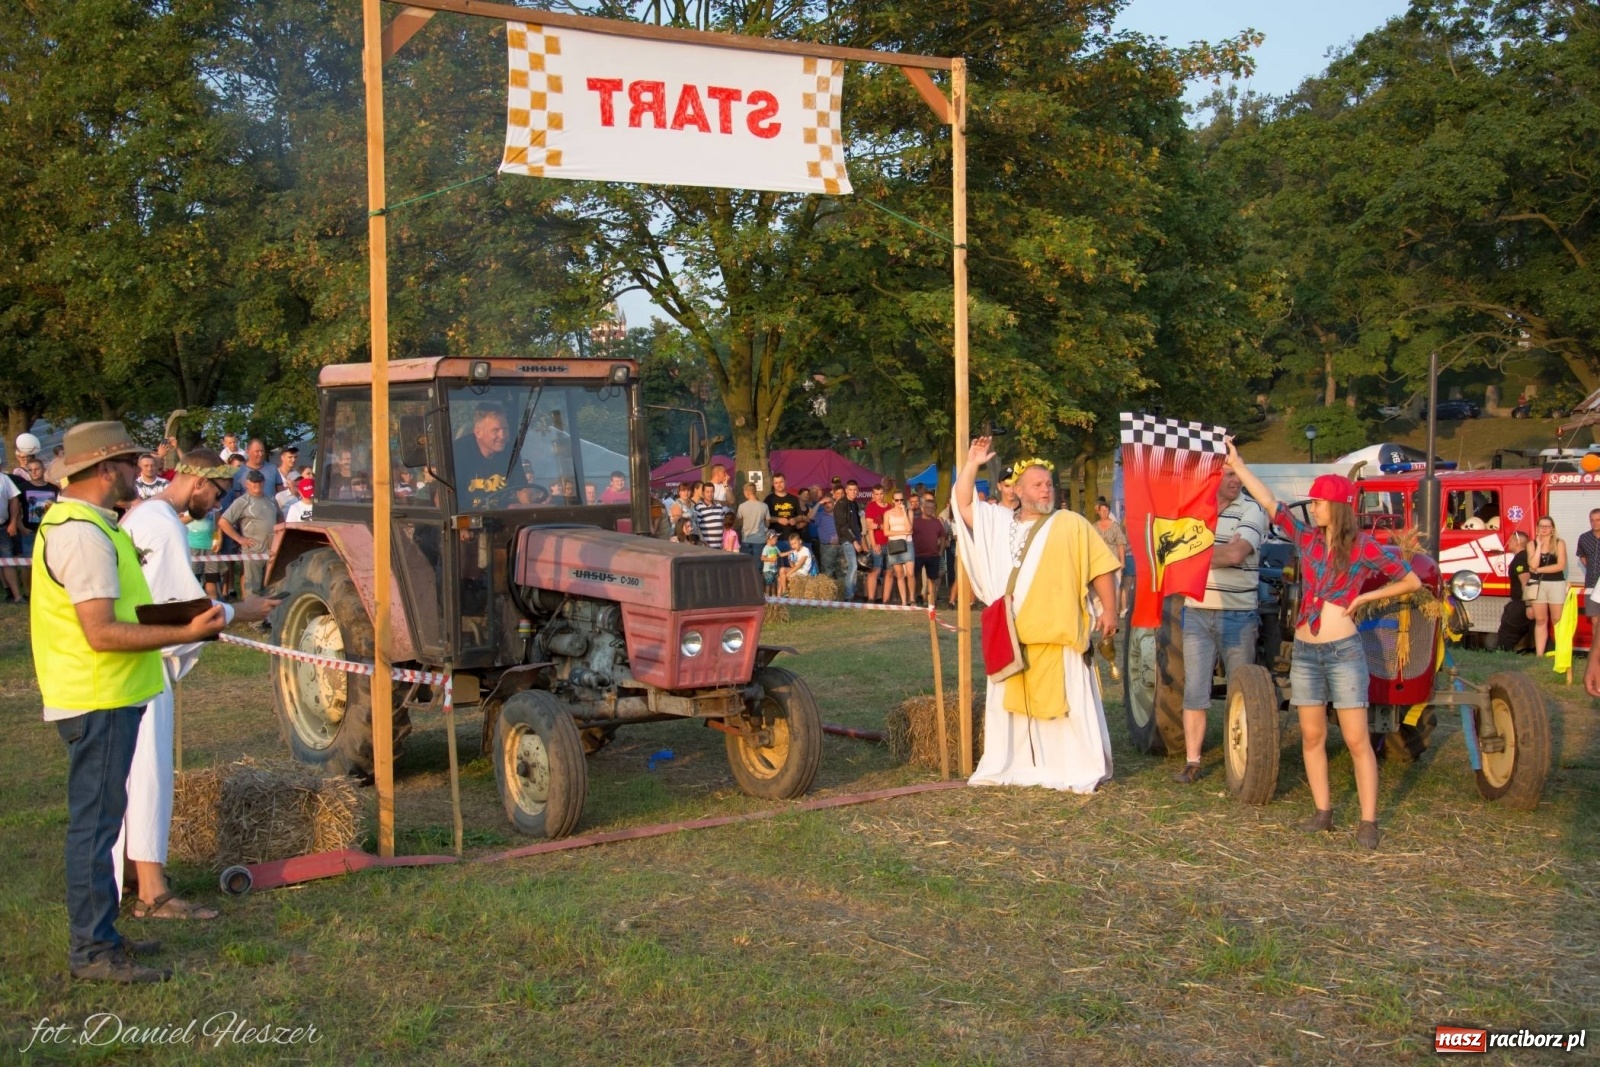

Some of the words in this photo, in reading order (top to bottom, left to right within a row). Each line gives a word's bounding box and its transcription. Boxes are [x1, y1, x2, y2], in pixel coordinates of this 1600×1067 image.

[518, 364, 568, 373] URSUS
[1558, 474, 1582, 483] 998
[573, 569, 617, 583] URSUS
